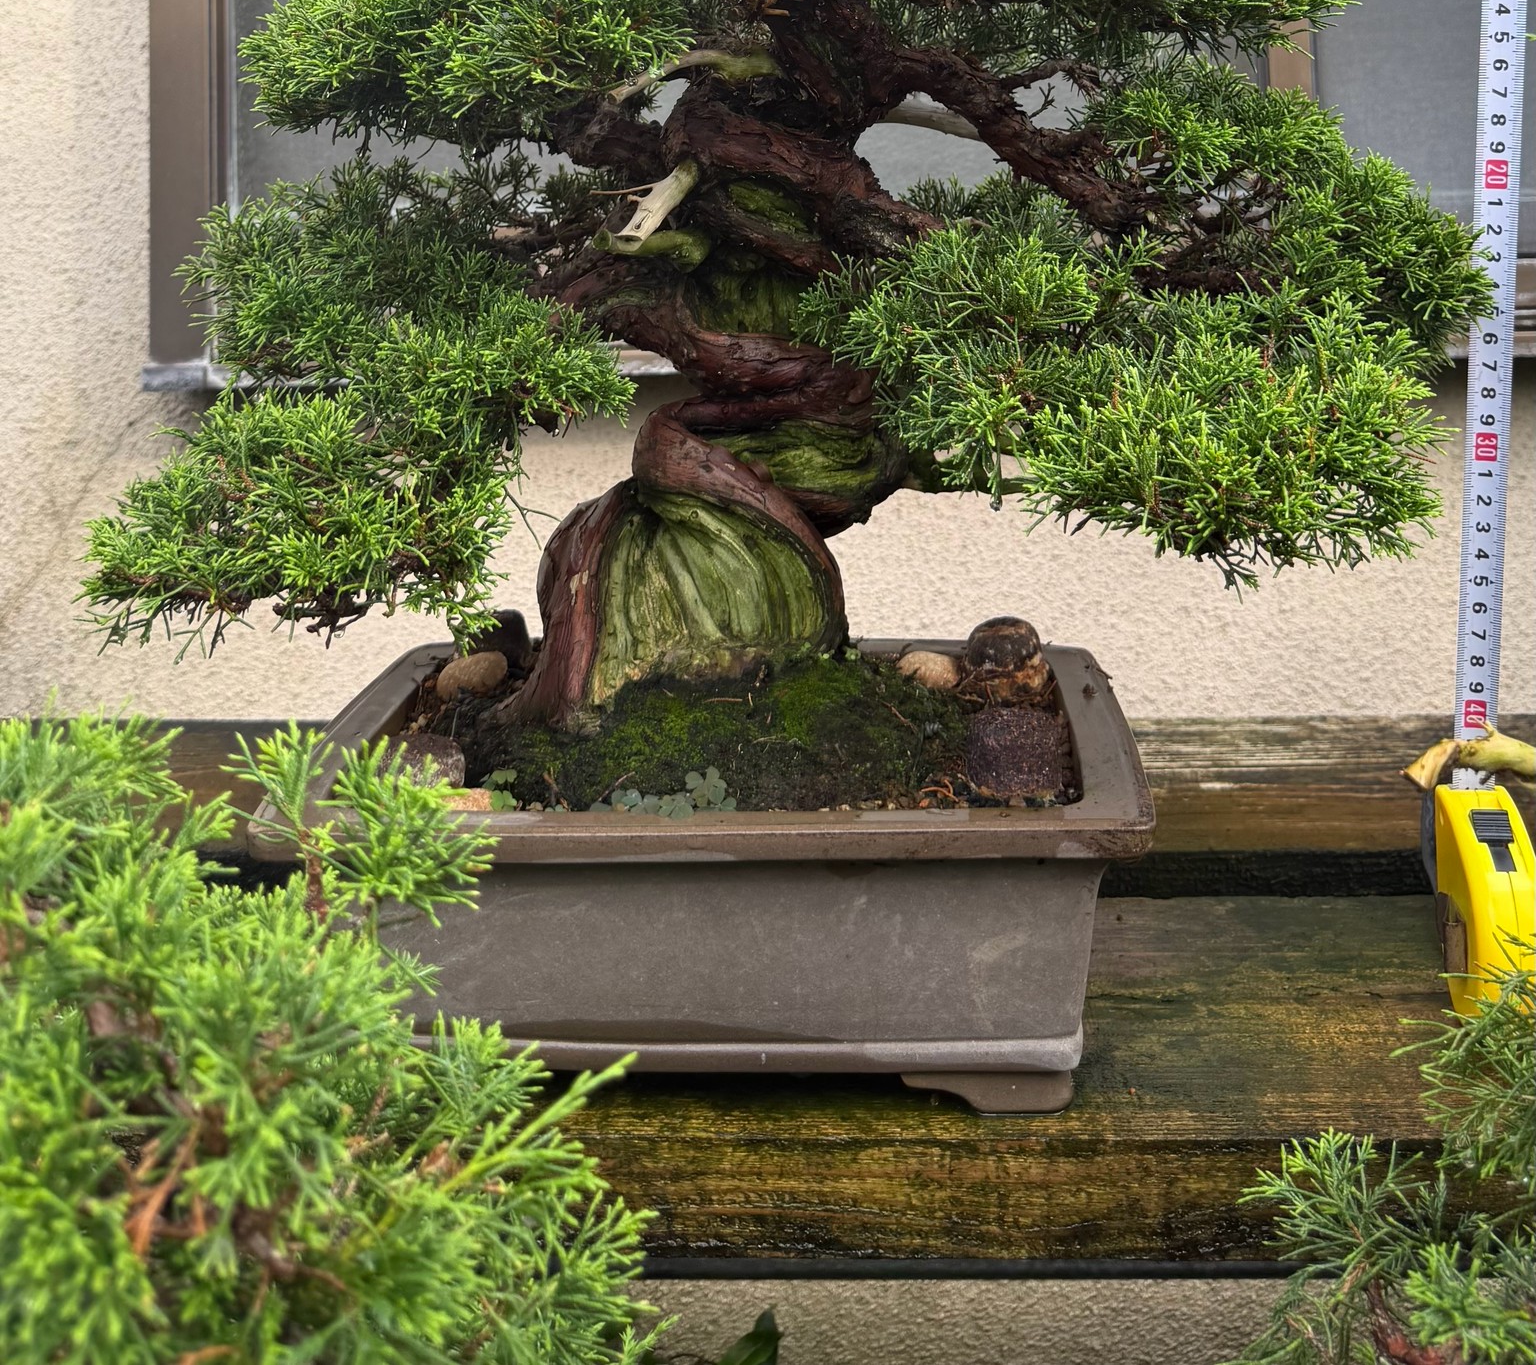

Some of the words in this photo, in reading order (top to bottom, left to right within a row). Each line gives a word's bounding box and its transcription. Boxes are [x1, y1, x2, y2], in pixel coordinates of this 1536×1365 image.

[1495, 4, 1511, 16] 4
[1494, 32, 1509, 43] 5
[1493, 59, 1509, 71] 6
[1492, 87, 1507, 98] 7
[1491, 114, 1506, 126] 8
[1490, 141, 1505, 153] 9
[1487, 165, 1507, 184] 20
[1488, 198, 1503, 206] 1
[1487, 224, 1502, 236] 2
[1483, 333, 1498, 345] 6
[1482, 360, 1497, 372] 7
[1481, 387, 1496, 399] 8
[1480, 414, 1495, 426] 9
[1477, 437, 1496, 457] 30
[1477, 495, 1492, 506] 2
[1476, 521, 1491, 533] 3
[1474, 548, 1490, 560] 4
[1473, 575, 1489, 587] 5
[1472, 602, 1488, 614] 6
[1471, 629, 1487, 641] 7
[1470, 655, 1486, 667] 8
[1469, 682, 1484, 694] 9
